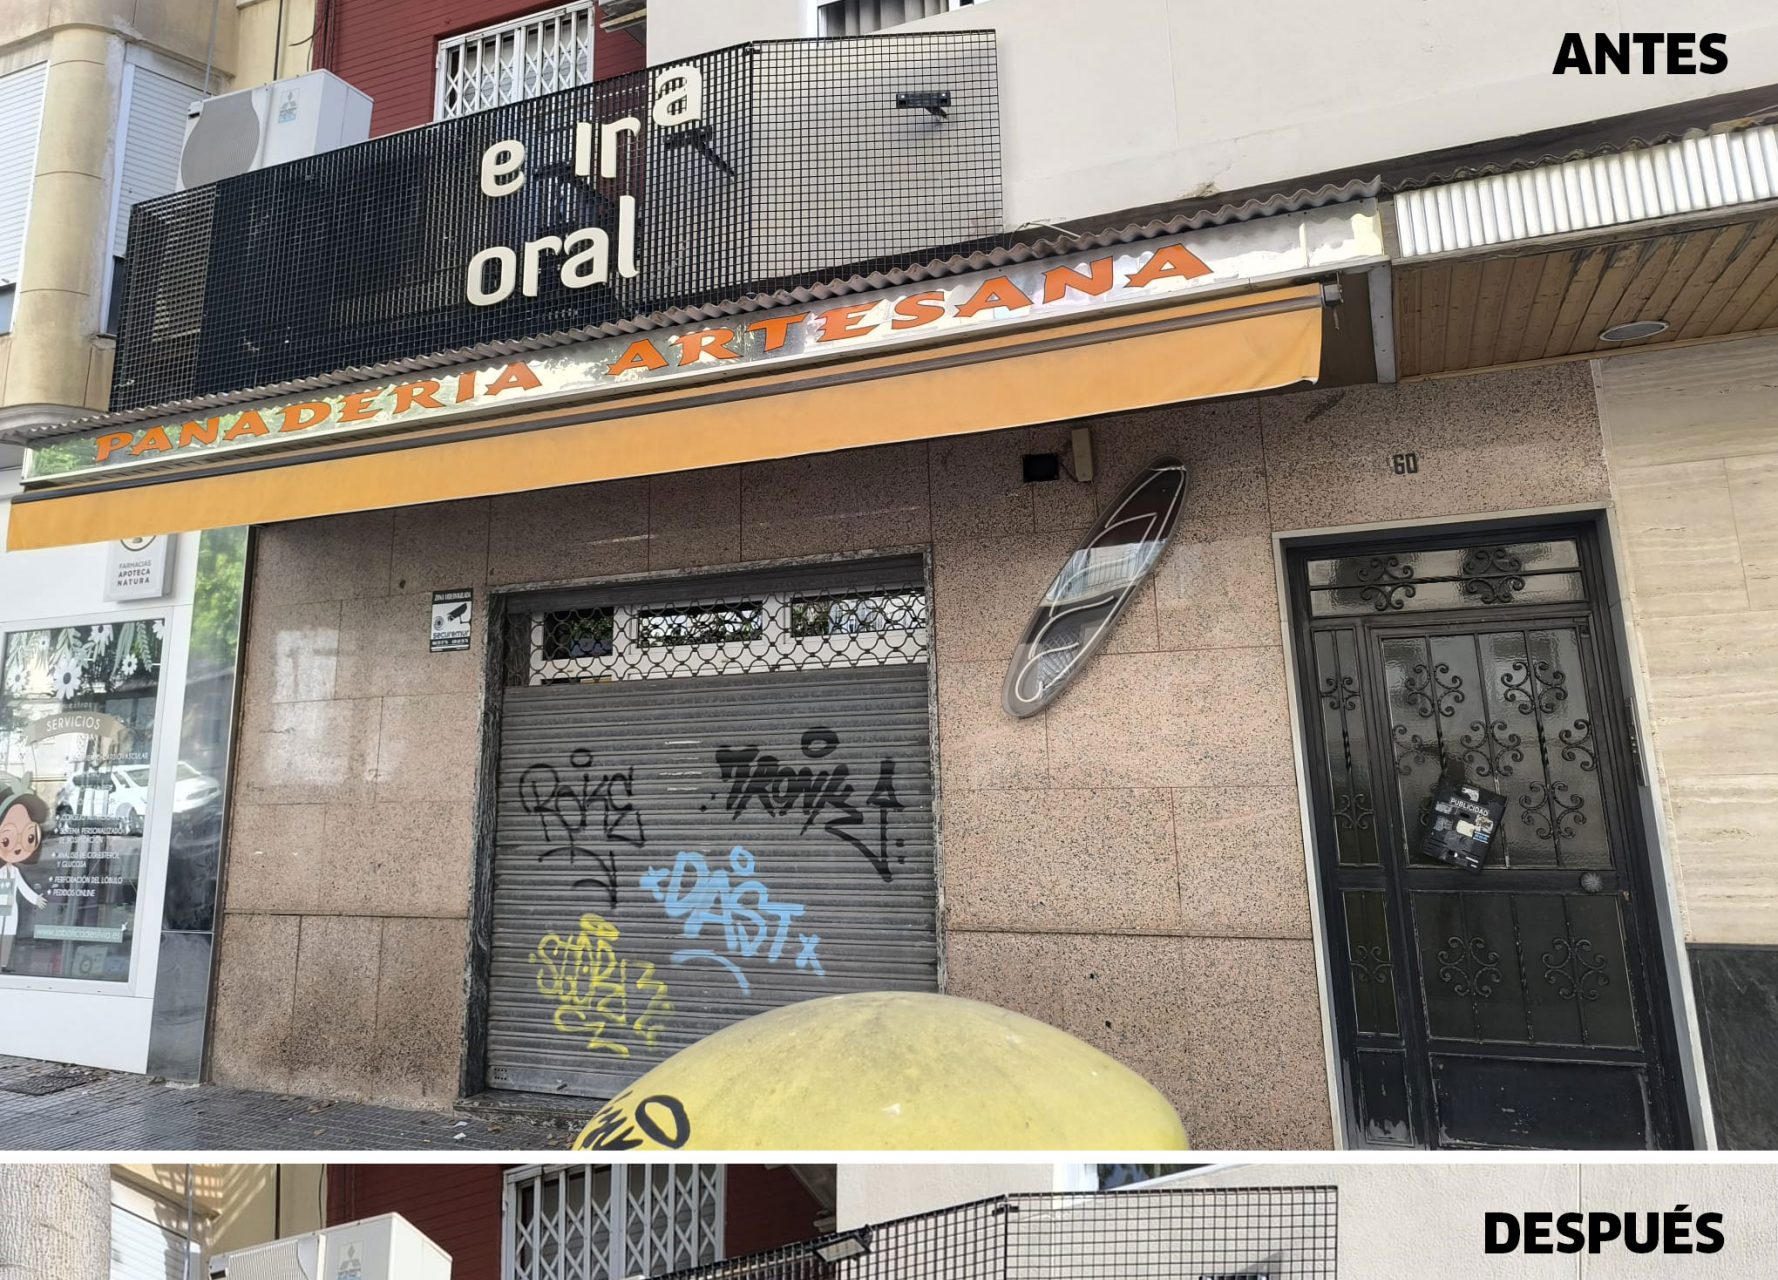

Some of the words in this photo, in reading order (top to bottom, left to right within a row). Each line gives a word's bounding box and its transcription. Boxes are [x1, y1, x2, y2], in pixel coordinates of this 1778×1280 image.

[467, 195, 639, 306] oral
[95, 360, 543, 463] PANADERIA
[606, 242, 1215, 376] ARTESANA
[1393, 453, 1417, 474] 60
[119, 560, 152, 569] FARMACIAS
[118, 568, 151, 578] APOTECA
[117, 577, 150, 586] NATURA
[46, 716, 101, 732] SERVICIOS
[1450, 797, 1490, 817] PUBLICIDAD
[53, 888, 75, 896] PEDIDOS
[75, 888, 96, 897] ONLINE
